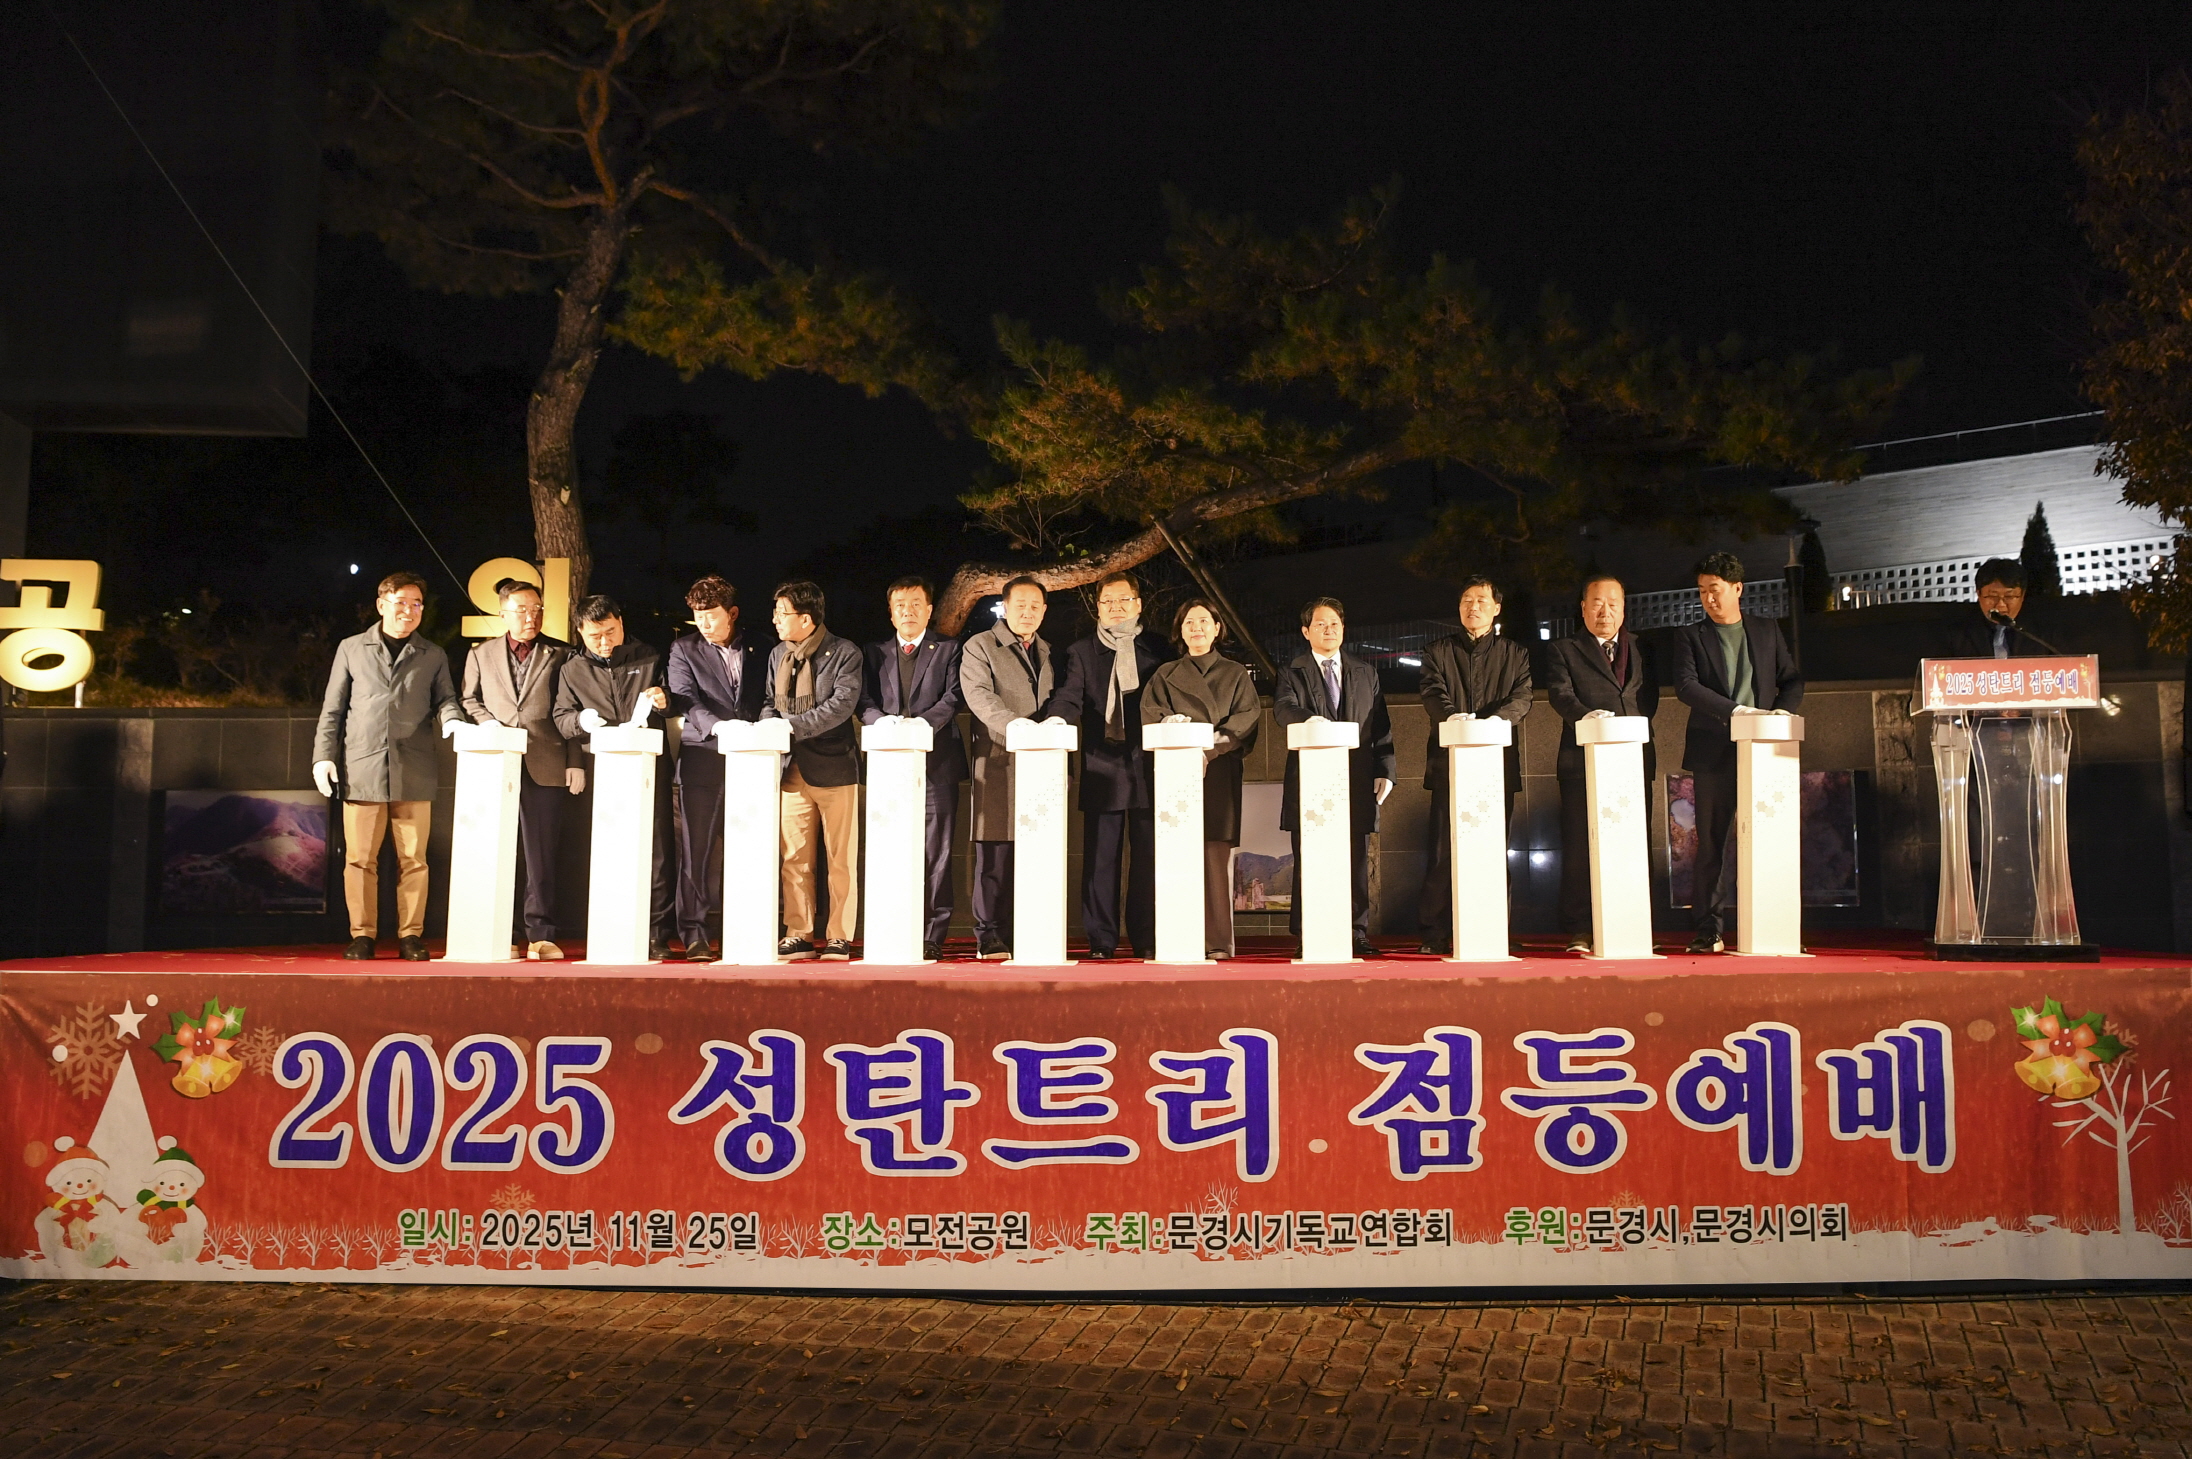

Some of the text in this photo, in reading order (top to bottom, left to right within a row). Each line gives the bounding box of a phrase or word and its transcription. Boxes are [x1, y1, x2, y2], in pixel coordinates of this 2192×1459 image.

[1946, 669, 2078, 696] 2025 성탄트리 점등예배
[269, 1021, 1955, 1182] 2025 성탄트리 점등예배
[610, 1209, 677, 1250] 11월
[687, 1211, 759, 1250] 25일
